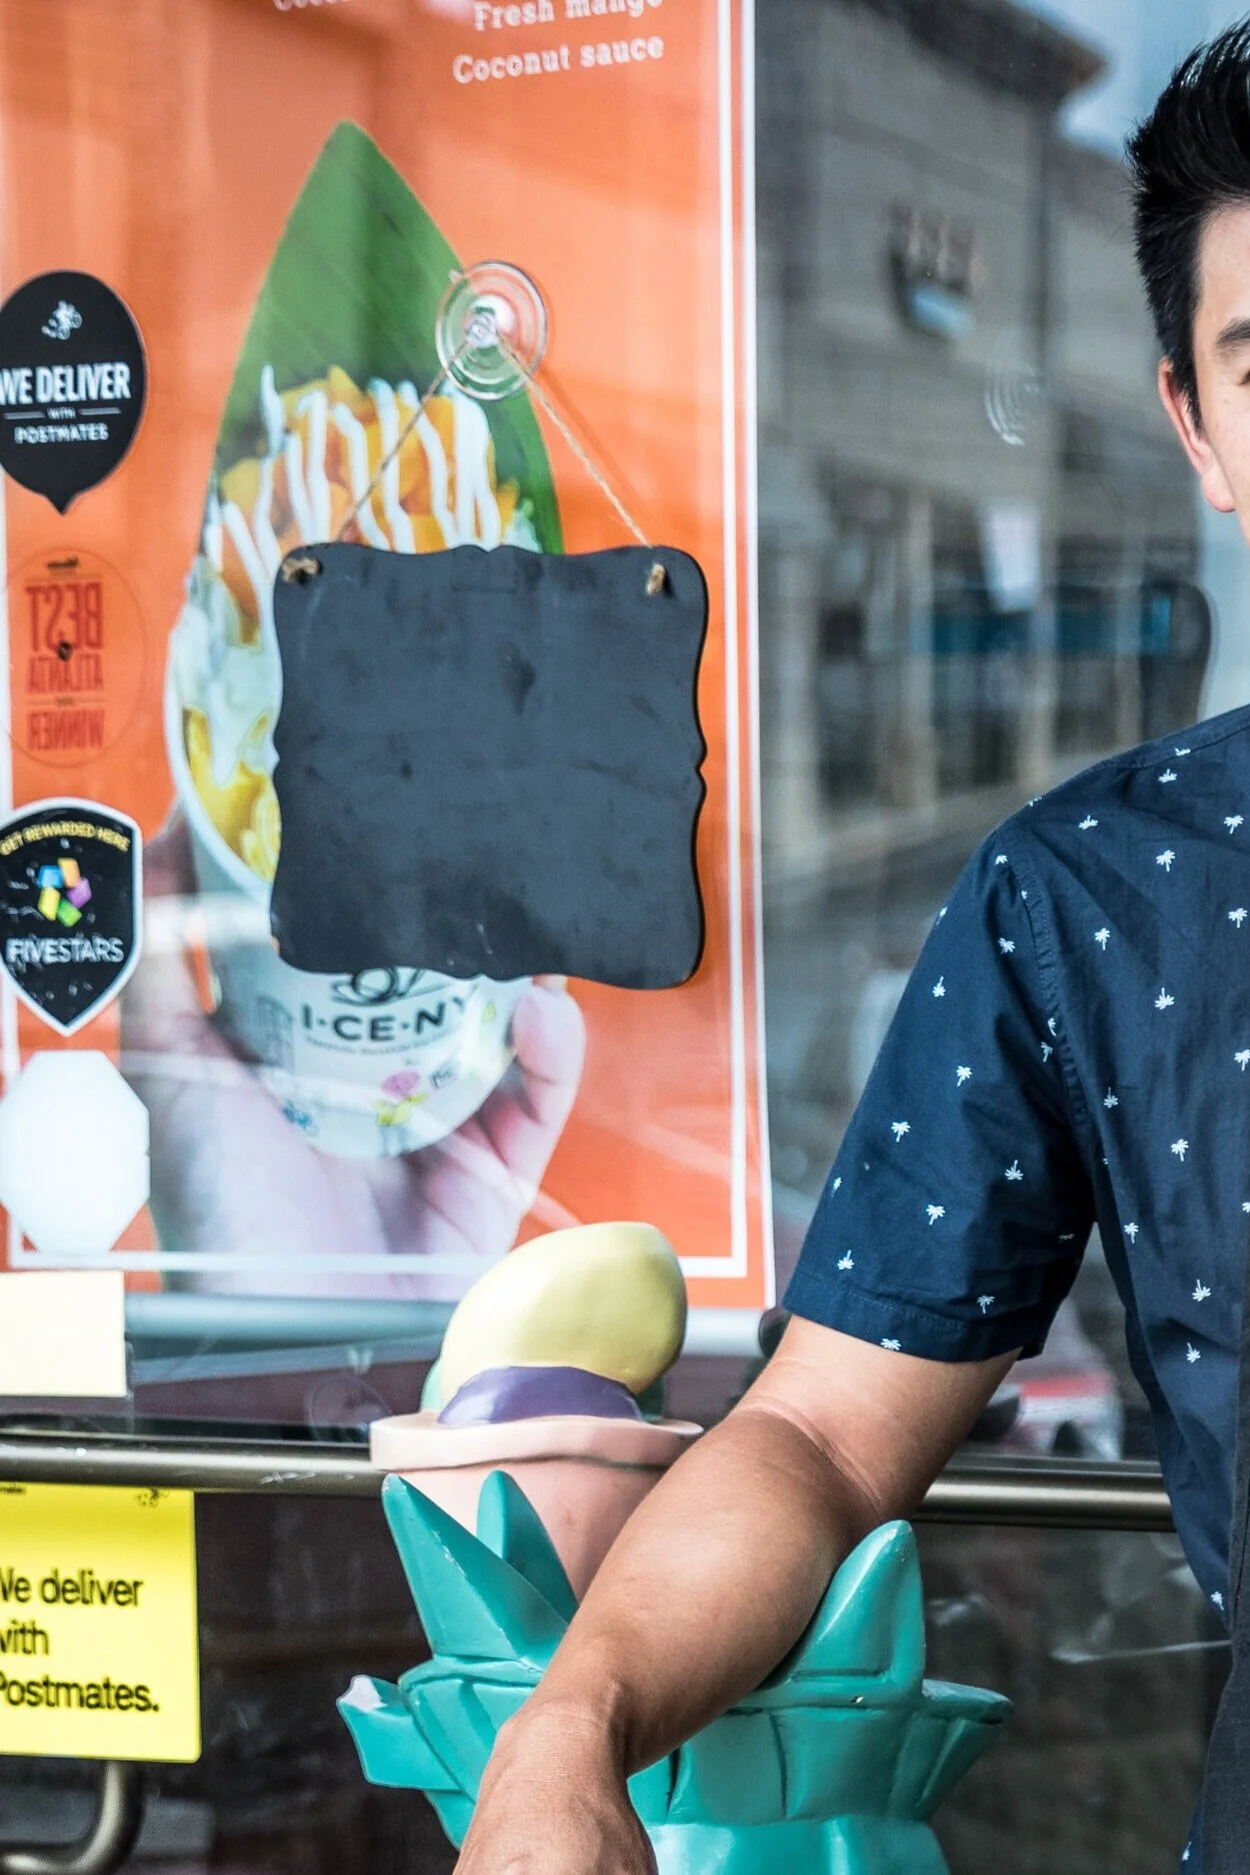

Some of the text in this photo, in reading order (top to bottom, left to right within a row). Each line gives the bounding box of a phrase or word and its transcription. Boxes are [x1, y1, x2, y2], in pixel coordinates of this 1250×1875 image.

[474, 0, 556, 31] Fresh
[452, 35, 664, 83] Coconut sauce
[0, 362, 131, 405] WE DELIVER
[14, 423, 109, 444] POSTMATES
[6, 938, 124, 963] FIVESTARS
[40, 1568, 143, 1606] deliver
